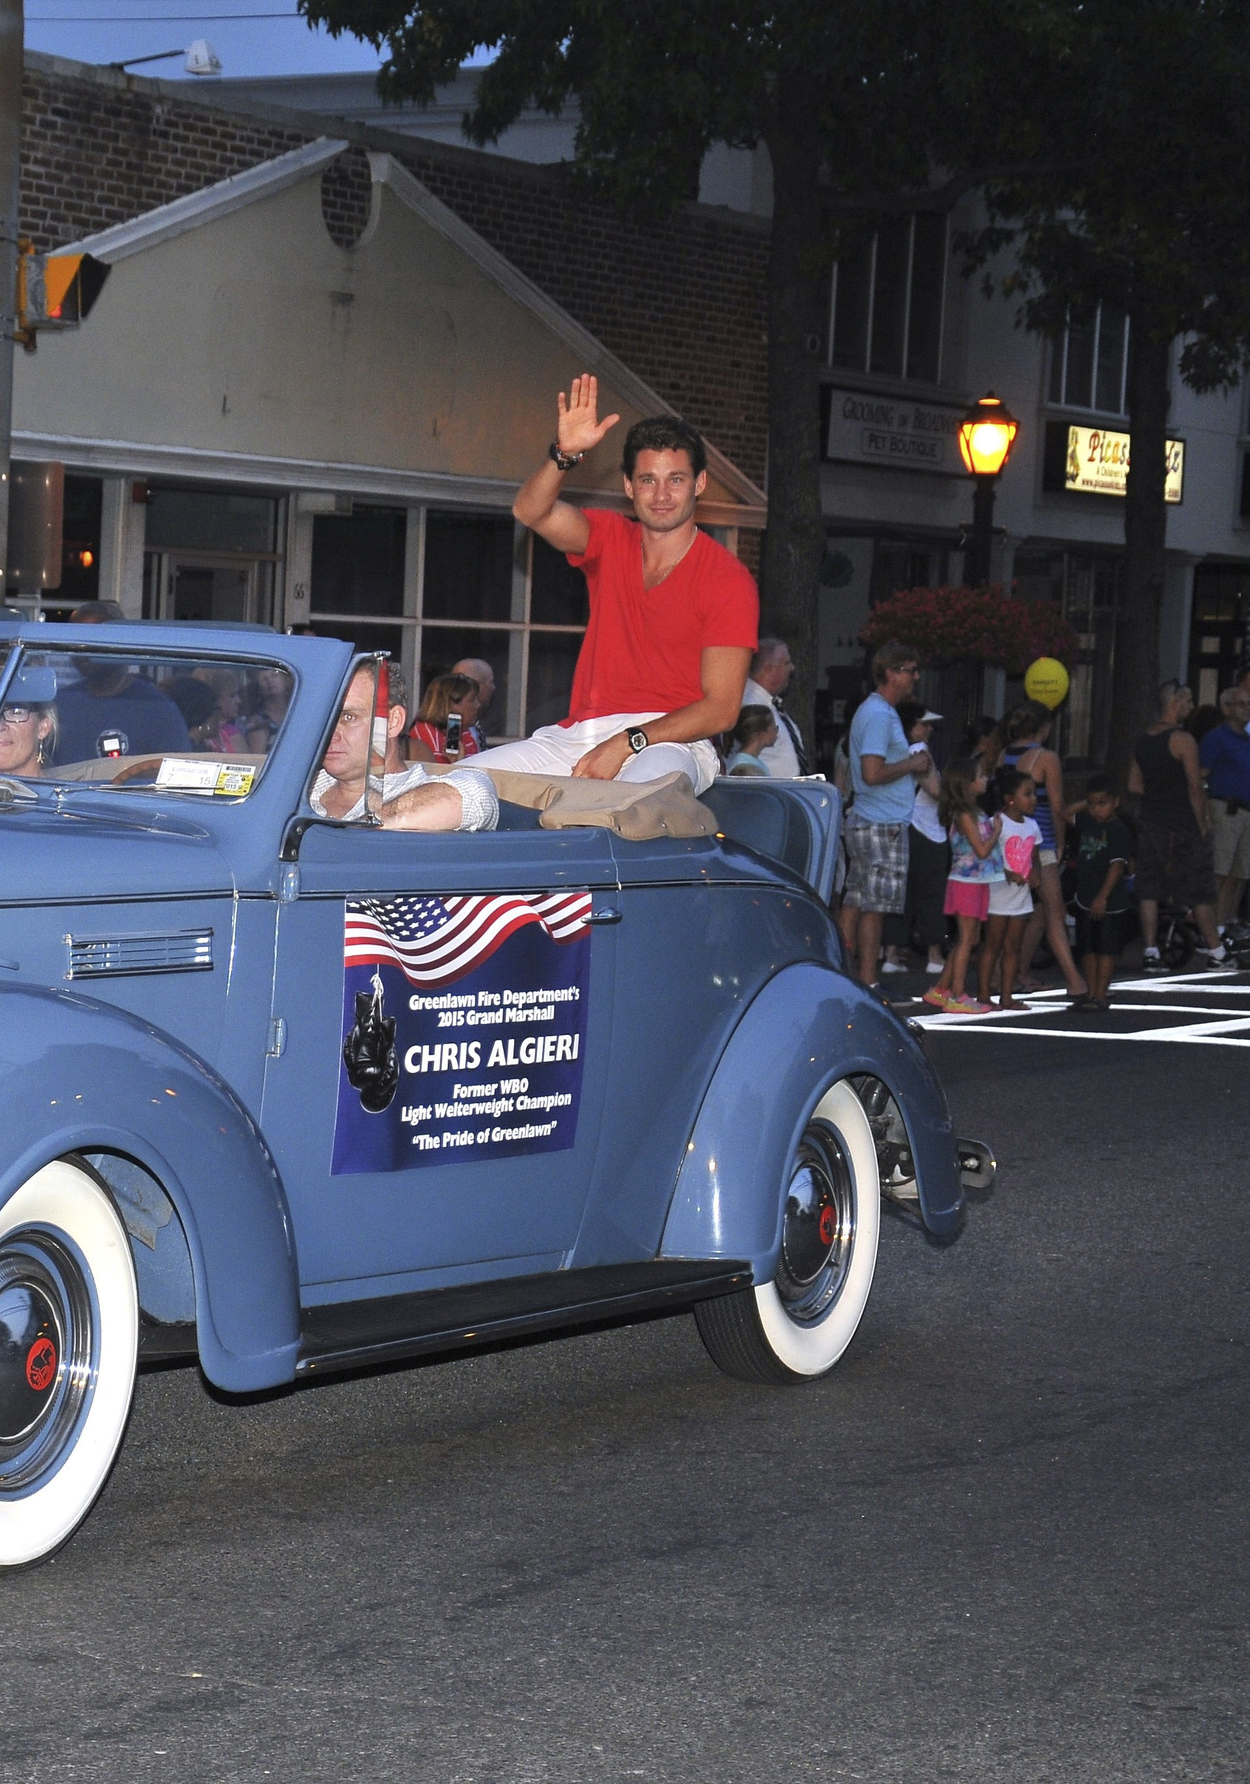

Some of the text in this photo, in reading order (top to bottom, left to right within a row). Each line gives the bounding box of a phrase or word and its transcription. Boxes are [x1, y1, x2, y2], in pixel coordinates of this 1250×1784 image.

[868, 433, 938, 459] PET BOUTIQUE
[167, 773, 211, 785] 7 15
[409, 986, 580, 1011] Greenlawn Fire Department's
[438, 1004, 555, 1028] 2015 Grand Marshall
[404, 1033, 580, 1074] CHRIS ALGIERI
[453, 1078, 529, 1099] Former WBO
[401, 1092, 572, 1126] Light Welterweight Champion
[442, 1129, 474, 1148] Pride
[476, 1127, 490, 1144] of
